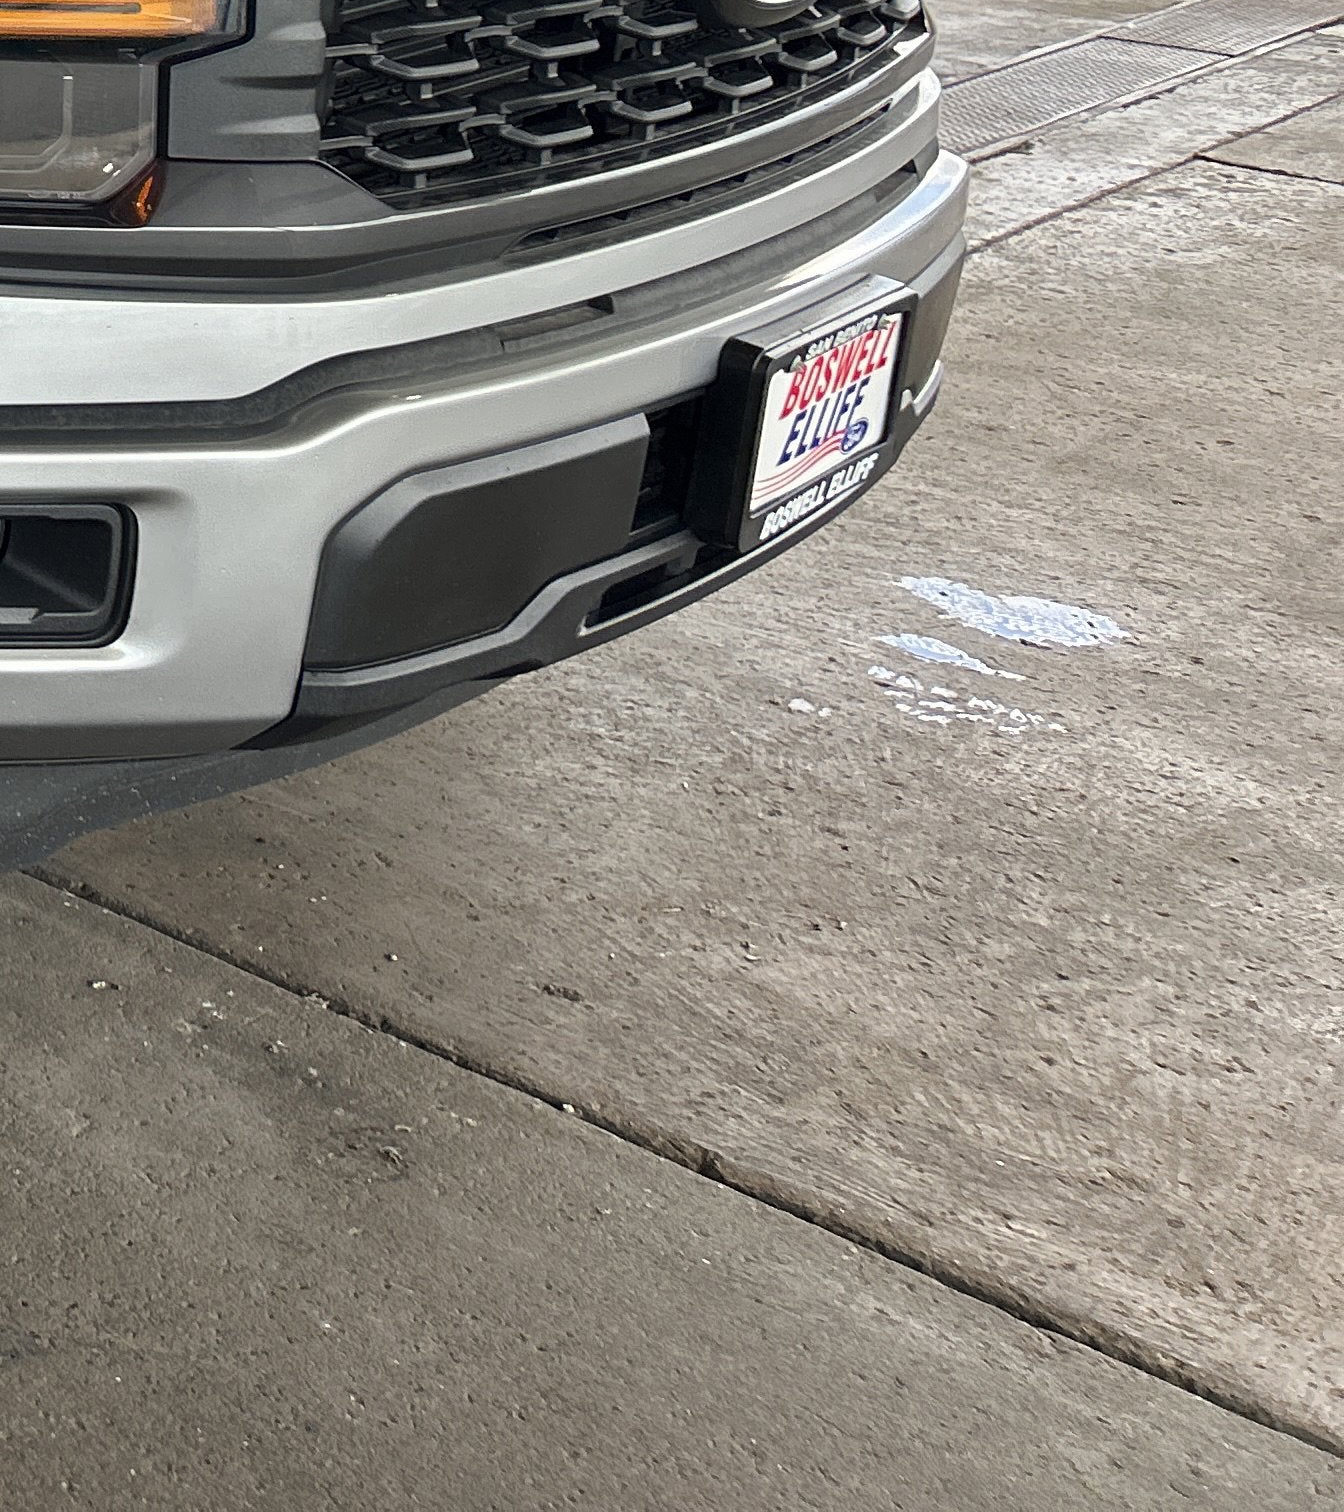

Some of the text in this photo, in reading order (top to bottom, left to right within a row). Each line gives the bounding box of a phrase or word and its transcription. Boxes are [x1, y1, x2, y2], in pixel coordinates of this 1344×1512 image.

[778, 321, 898, 420] BOSWELL
[806, 334, 834, 360] SAN
[776, 376, 872, 467] ELLIFF
[759, 452, 880, 540] BOSWELL ELLIFF
